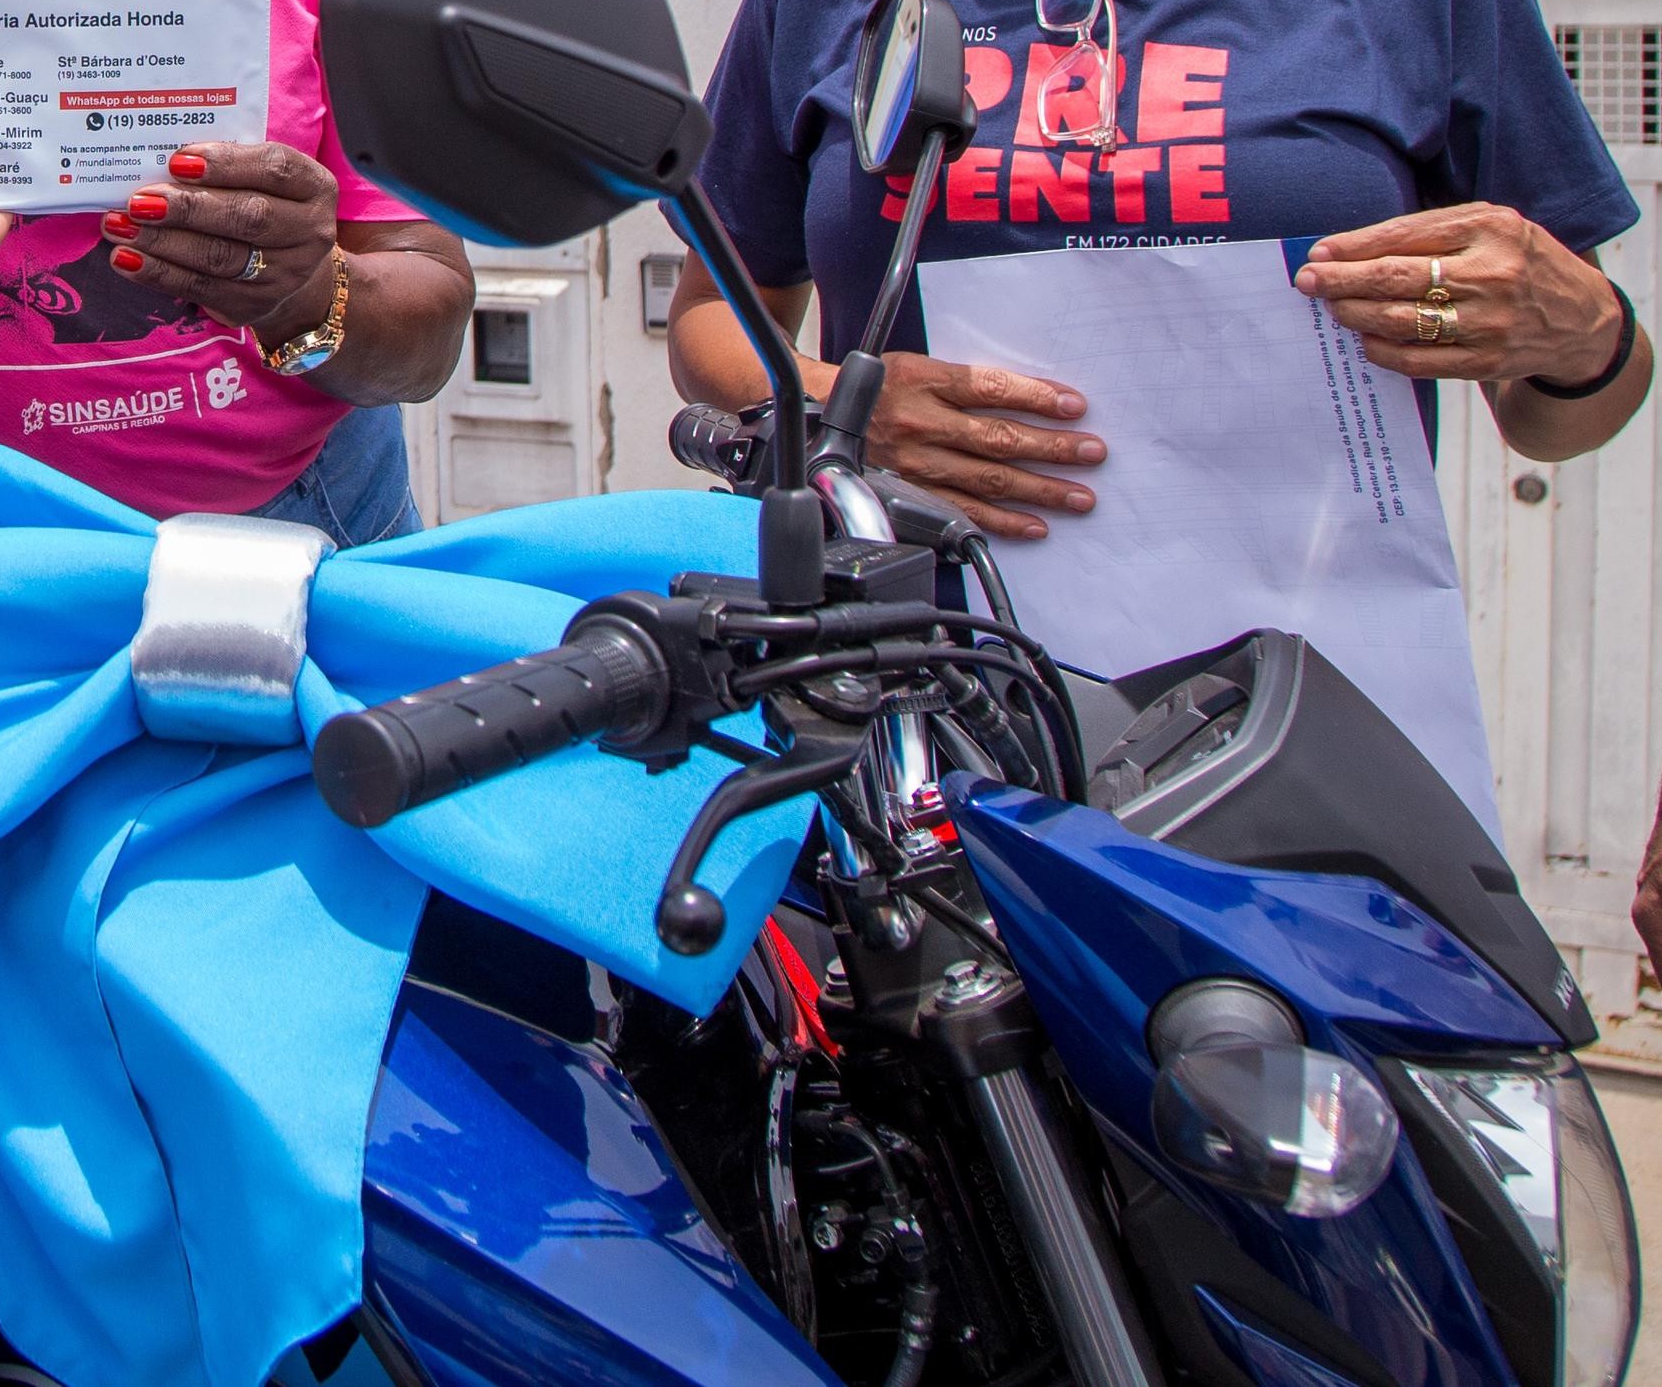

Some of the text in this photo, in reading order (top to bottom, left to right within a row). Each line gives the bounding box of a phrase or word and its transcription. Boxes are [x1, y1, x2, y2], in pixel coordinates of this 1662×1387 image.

[25, 12, 121, 29] Autorizada
[127, 11, 184, 27] Honda
[962, 26, 997, 42] NOS
[81, 56, 132, 68] Bárbara
[58, 71, 74, 80] (19)
[66, 94, 233, 108] WhatsApp de todas nossas lojas:
[107, 112, 215, 130] (19) 98855-2823
[60, 145, 78, 153] Nos
[80, 145, 131, 154] acompanhe
[132, 144, 146, 152] em
[148, 143, 178, 151] nossas
[75, 158, 142, 167] /mundialmotos
[75, 174, 142, 183] /mundialmotos
[1319, 341, 1336, 387] Campinas
[1362, 372, 1372, 385] SP
[1331, 390, 1340, 401] de
[1350, 395, 1359, 407] de
[49, 387, 183, 423] SINSAÚDE
[1369, 393, 1385, 438] Campinas
[72, 414, 166, 435] CAMPINAS E REGIÃO
[1354, 409, 1367, 439] Duque
[1342, 435, 1351, 445] da
[1362, 441, 1372, 458] Rua
[1377, 501, 1388, 523] Sede
[1393, 495, 1405, 516] CEP:
